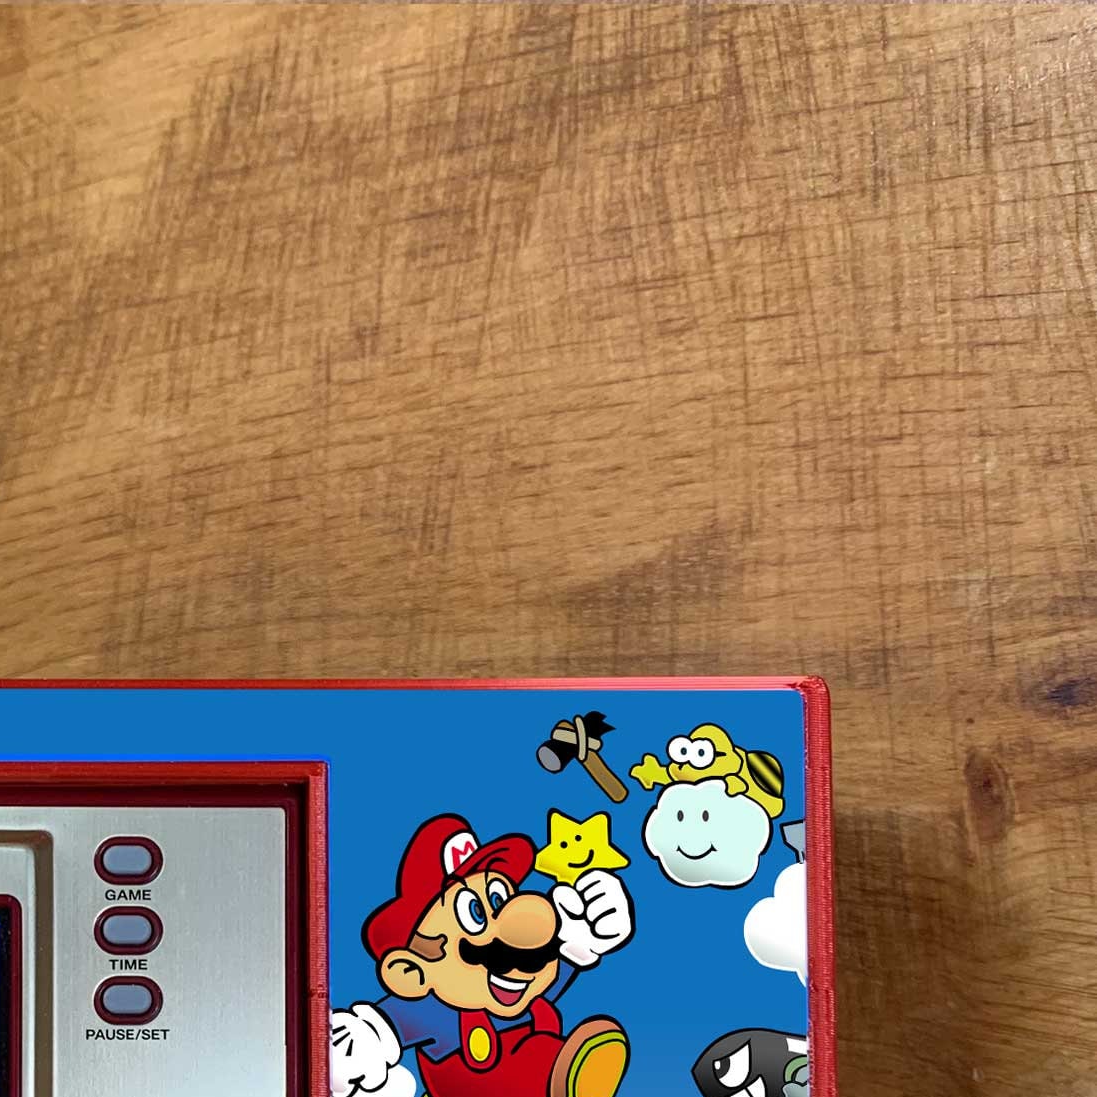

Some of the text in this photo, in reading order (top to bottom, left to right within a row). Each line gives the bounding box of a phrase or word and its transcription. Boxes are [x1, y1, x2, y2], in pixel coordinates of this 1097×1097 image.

[104, 889, 152, 901] GAME
[108, 959, 149, 971] TIME
[85, 1029, 171, 1041] PAUSE/SET
